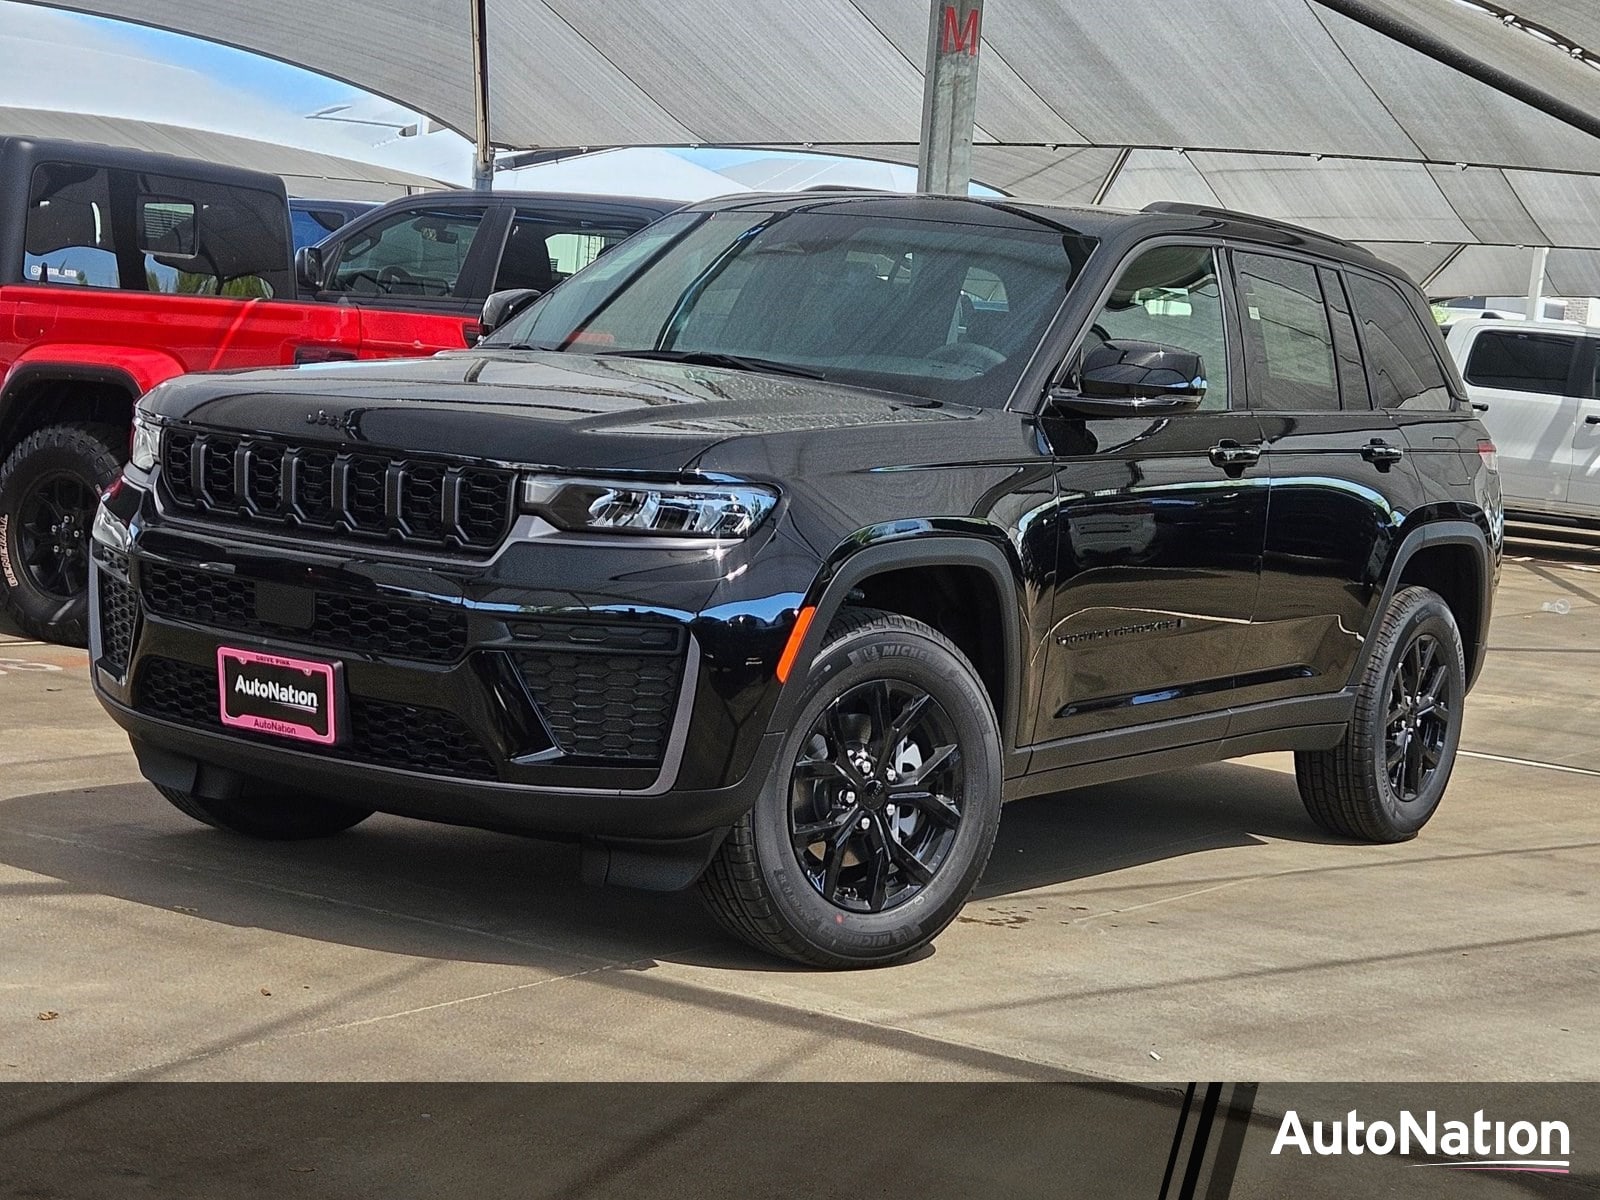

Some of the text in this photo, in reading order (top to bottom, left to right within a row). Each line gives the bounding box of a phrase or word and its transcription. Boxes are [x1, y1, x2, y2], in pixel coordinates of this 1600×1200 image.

[943, 6, 979, 56] M
[235, 675, 319, 707] AutoNation
[254, 718, 296, 735] AutoNation
